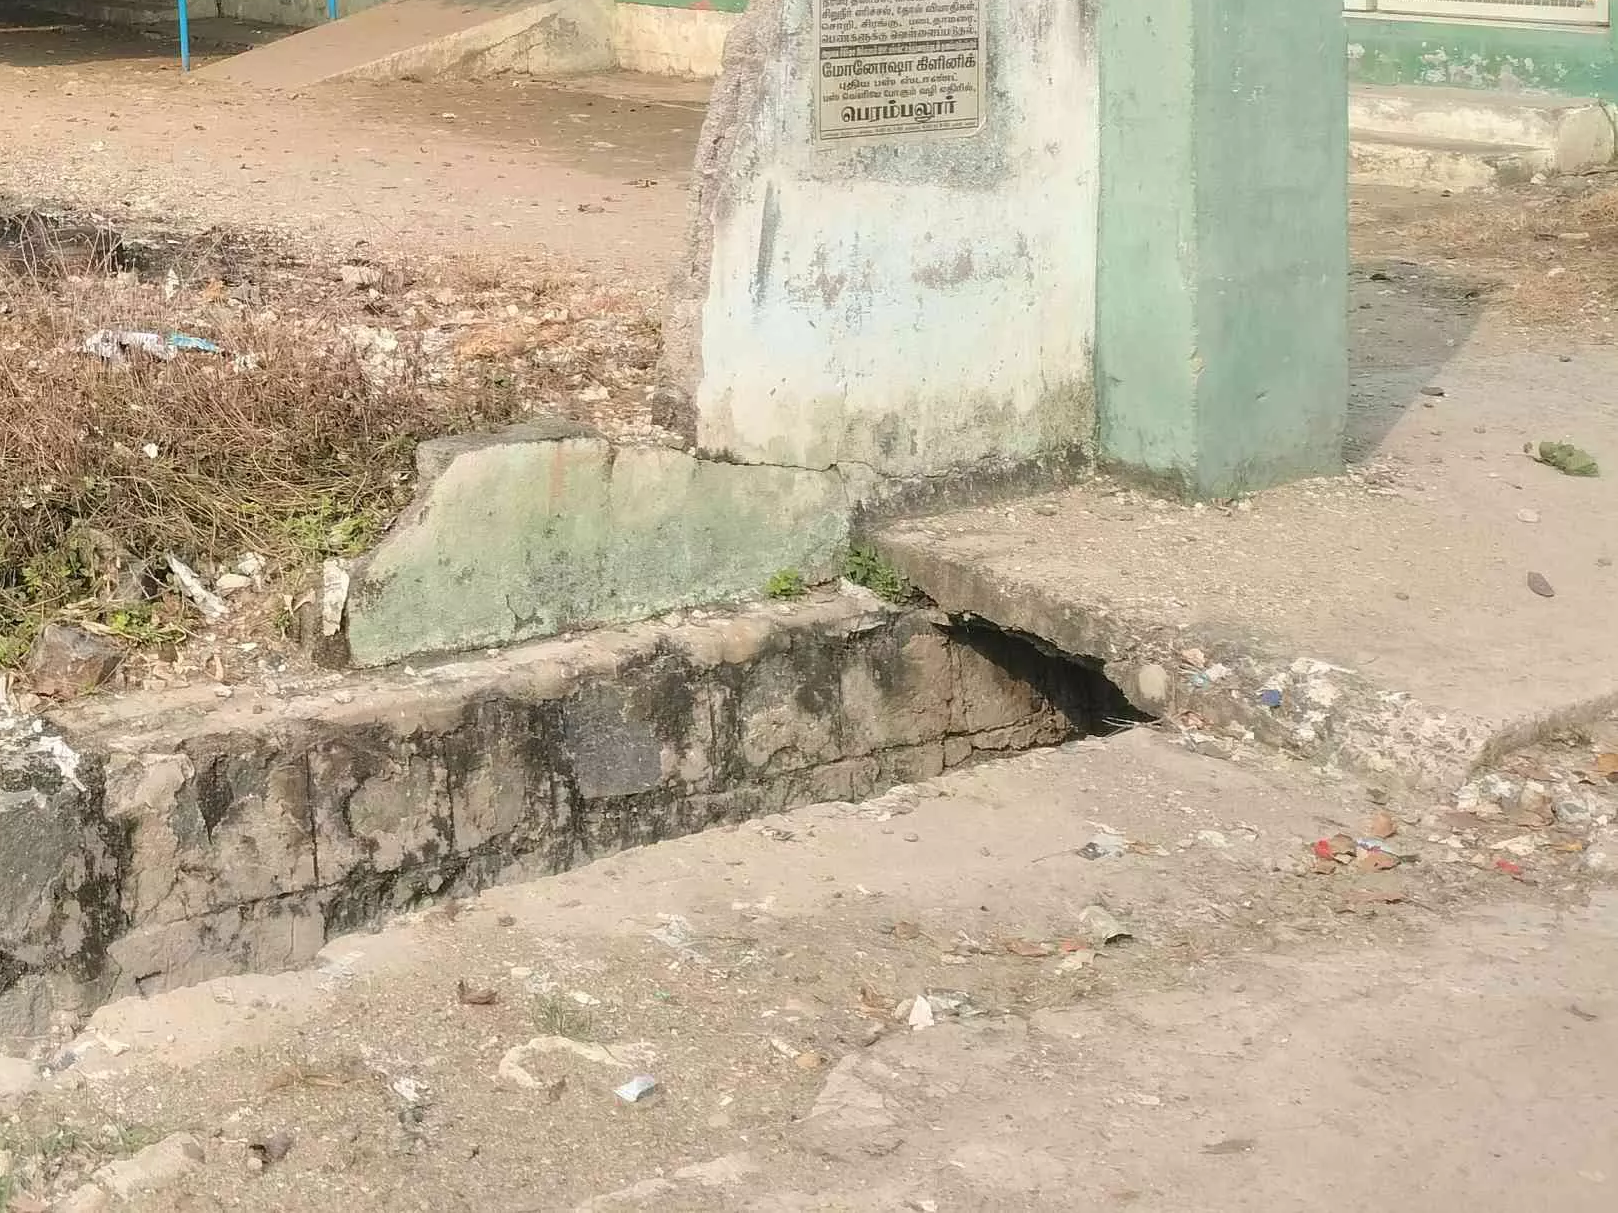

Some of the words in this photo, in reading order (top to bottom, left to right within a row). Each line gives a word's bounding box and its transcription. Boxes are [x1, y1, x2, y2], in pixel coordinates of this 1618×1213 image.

[916, 53, 976, 72] கிளினிக்
[839, 79, 870, 91] புதிய
[841, 95, 957, 123] பெரம்பலூர்
